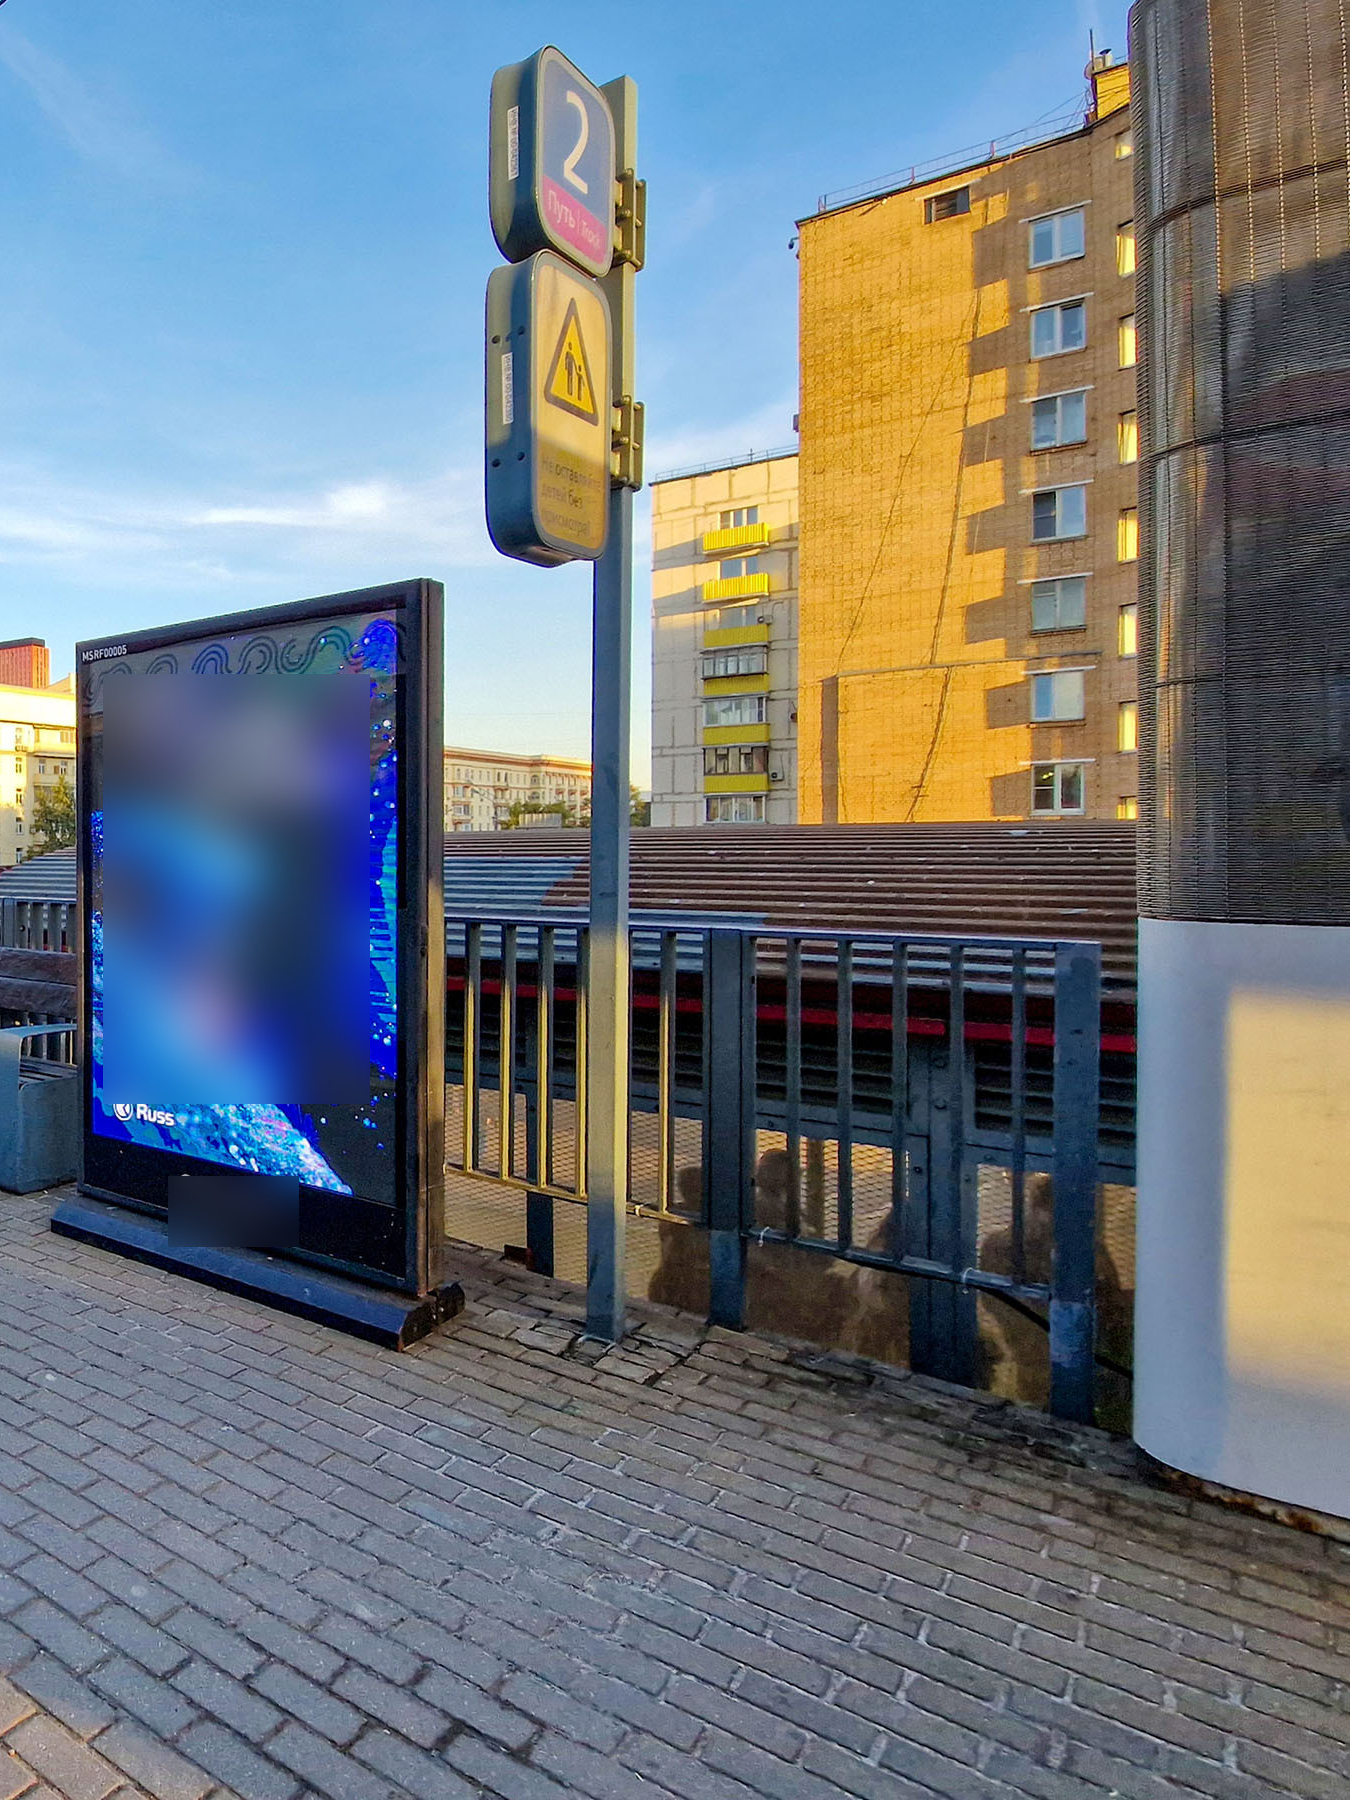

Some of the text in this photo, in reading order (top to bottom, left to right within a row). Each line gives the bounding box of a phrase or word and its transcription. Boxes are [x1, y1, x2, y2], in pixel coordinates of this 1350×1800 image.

[564, 90, 588, 194] 2
[548, 190, 576, 229] Путь
[568, 488, 583, 511] без
[82, 645, 127, 662] MSRF00005
[136, 1103, 175, 1127] Russ
